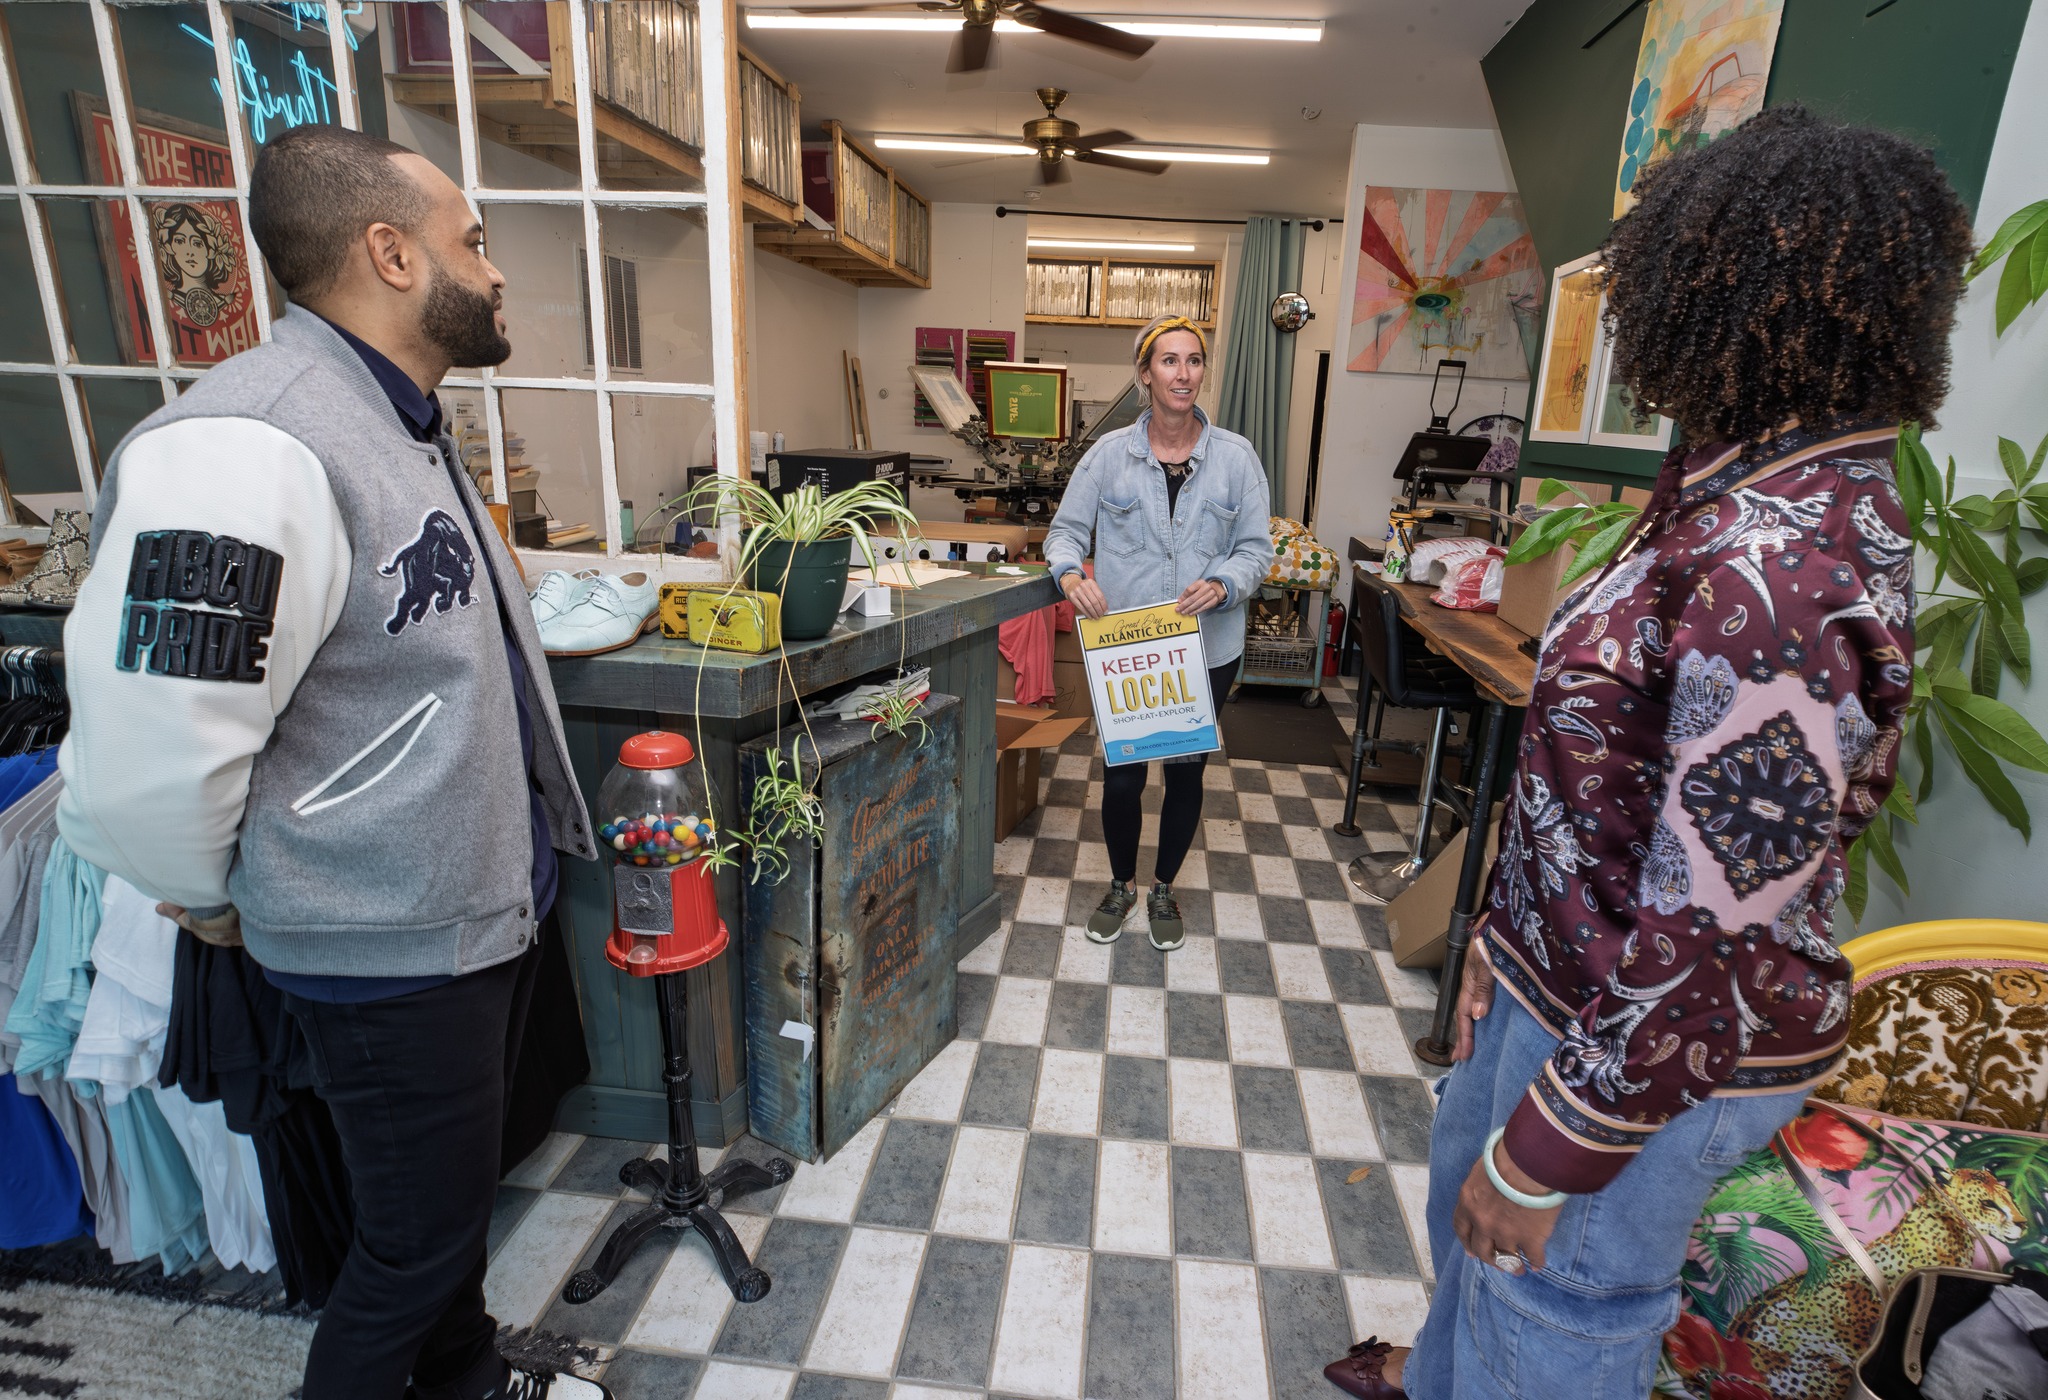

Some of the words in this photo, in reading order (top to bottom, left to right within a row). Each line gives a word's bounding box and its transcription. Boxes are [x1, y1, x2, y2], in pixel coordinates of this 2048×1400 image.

[126, 528, 284, 622] HBCU
[1098, 627, 1153, 645] ATLANTIC
[1156, 621, 1182, 635] CITY
[1113, 619, 1141, 634] Great
[1141, 613, 1164, 630] Day
[116, 604, 274, 684] PRIDE
[1101, 653, 1161, 676] KEEP
[1168, 648, 1187, 666] IT
[1105, 668, 1197, 715] LOCAL
[903, 796, 937, 826] PARTS
[875, 921, 911, 958] ONLY
